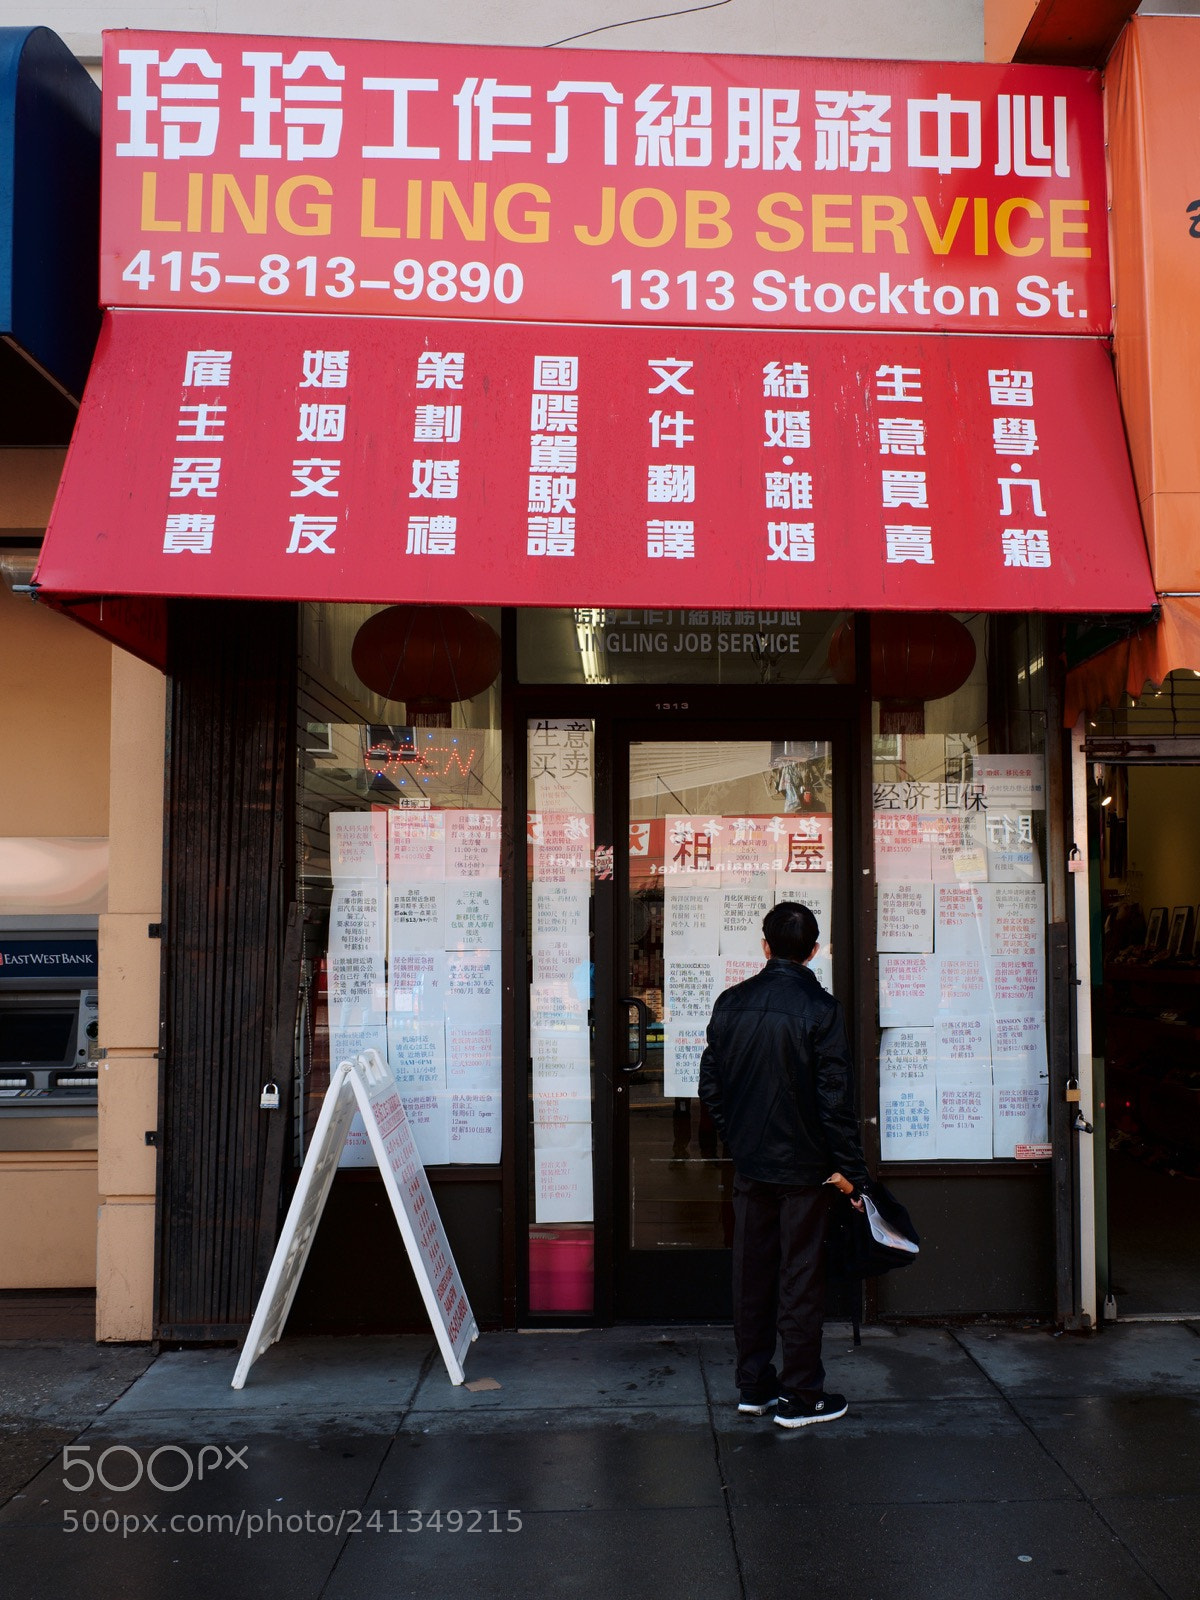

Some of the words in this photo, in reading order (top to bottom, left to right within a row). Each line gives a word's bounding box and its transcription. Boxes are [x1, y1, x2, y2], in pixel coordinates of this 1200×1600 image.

[116, 48, 1070, 178] 玲玲工作介紹服務中心
[141, 172, 334, 236] LING
[361, 178, 551, 243] LING
[574, 187, 733, 249] JOB
[755, 192, 1092, 258] SERVICE
[611, 268, 735, 311] 1313
[752, 269, 999, 316] Stockton
[1016, 275, 1088, 318] St.
[163, 351, 232, 554] 雇主免費
[286, 350, 349, 554] 婚姻交友
[646, 357, 695, 559] 文件翻譯
[876, 365, 935, 565] 生意買賣
[574, 633, 669, 653] LINGLING
[673, 634, 712, 653] JOB
[717, 634, 800, 653] SERVICE
[655, 702, 689, 710] 1313
[532, 720, 590, 749] 生意
[364, 744, 477, 776] OPEN
[531, 750, 590, 779] 买卖
[873, 782, 989, 811] 经济担保
